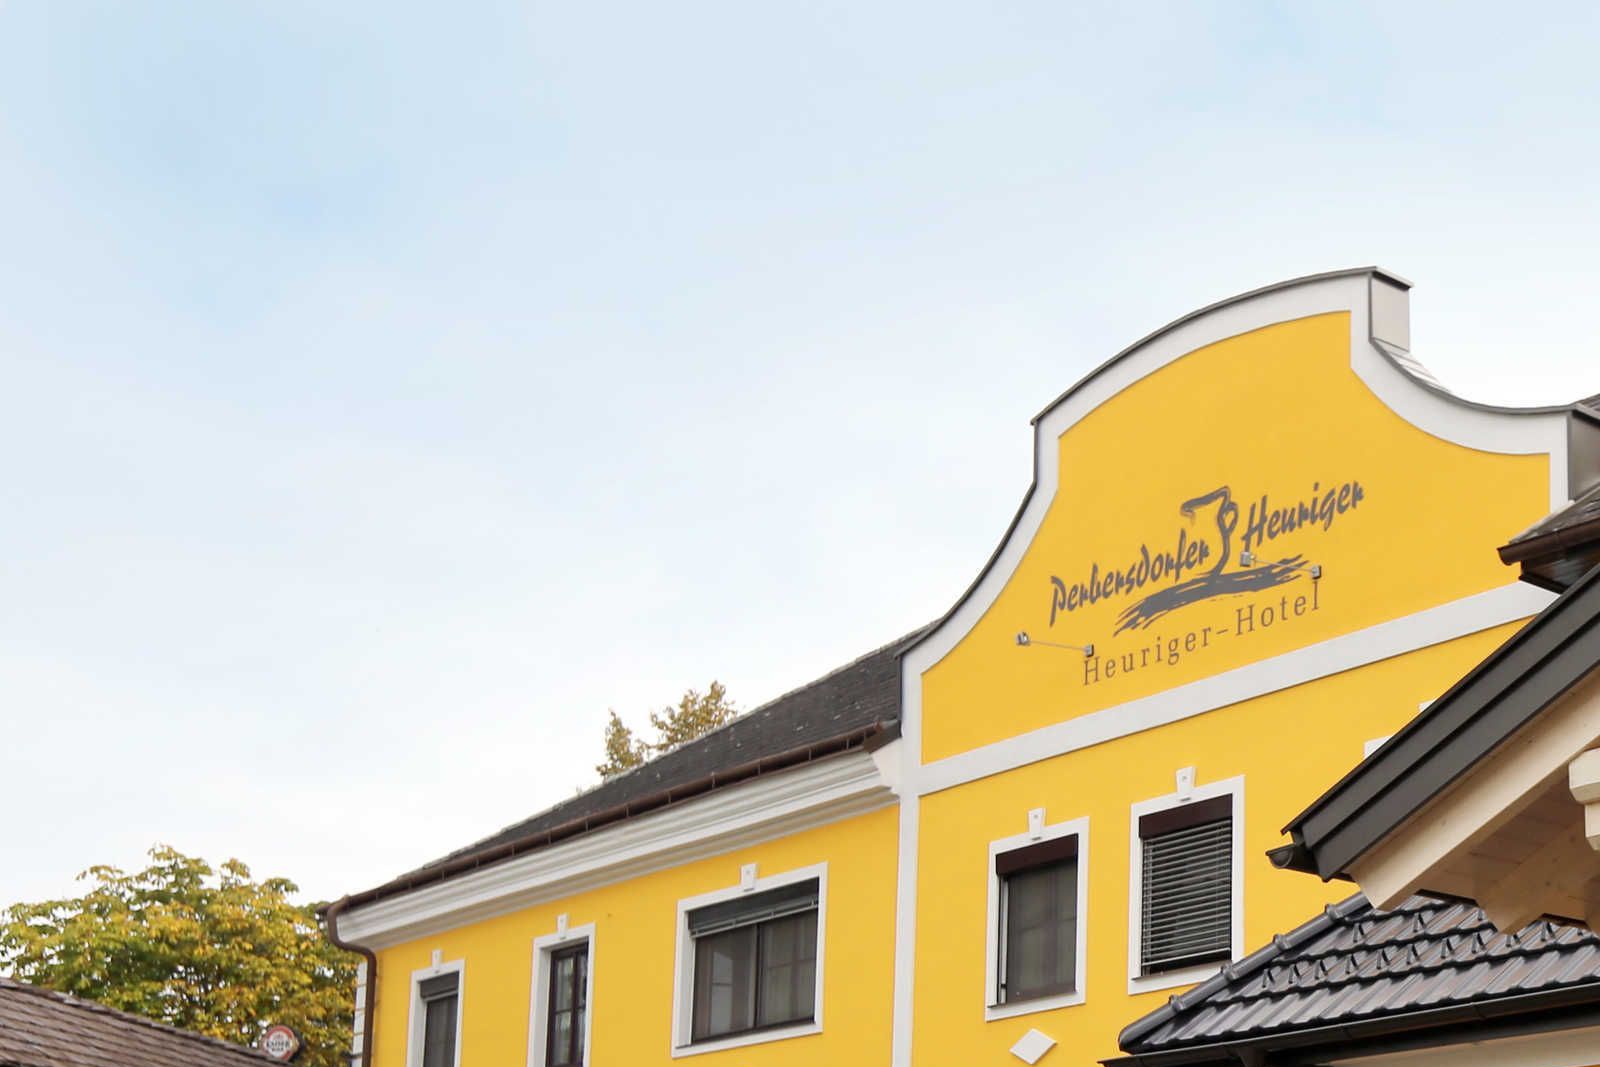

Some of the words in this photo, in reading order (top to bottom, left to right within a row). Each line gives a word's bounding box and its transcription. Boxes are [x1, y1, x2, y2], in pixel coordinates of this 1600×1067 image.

[1050, 529, 1209, 628] Perbersdorfer
[1241, 481, 1364, 551] Heuriger
[1083, 583, 1320, 687] Heuriger-Hotel
